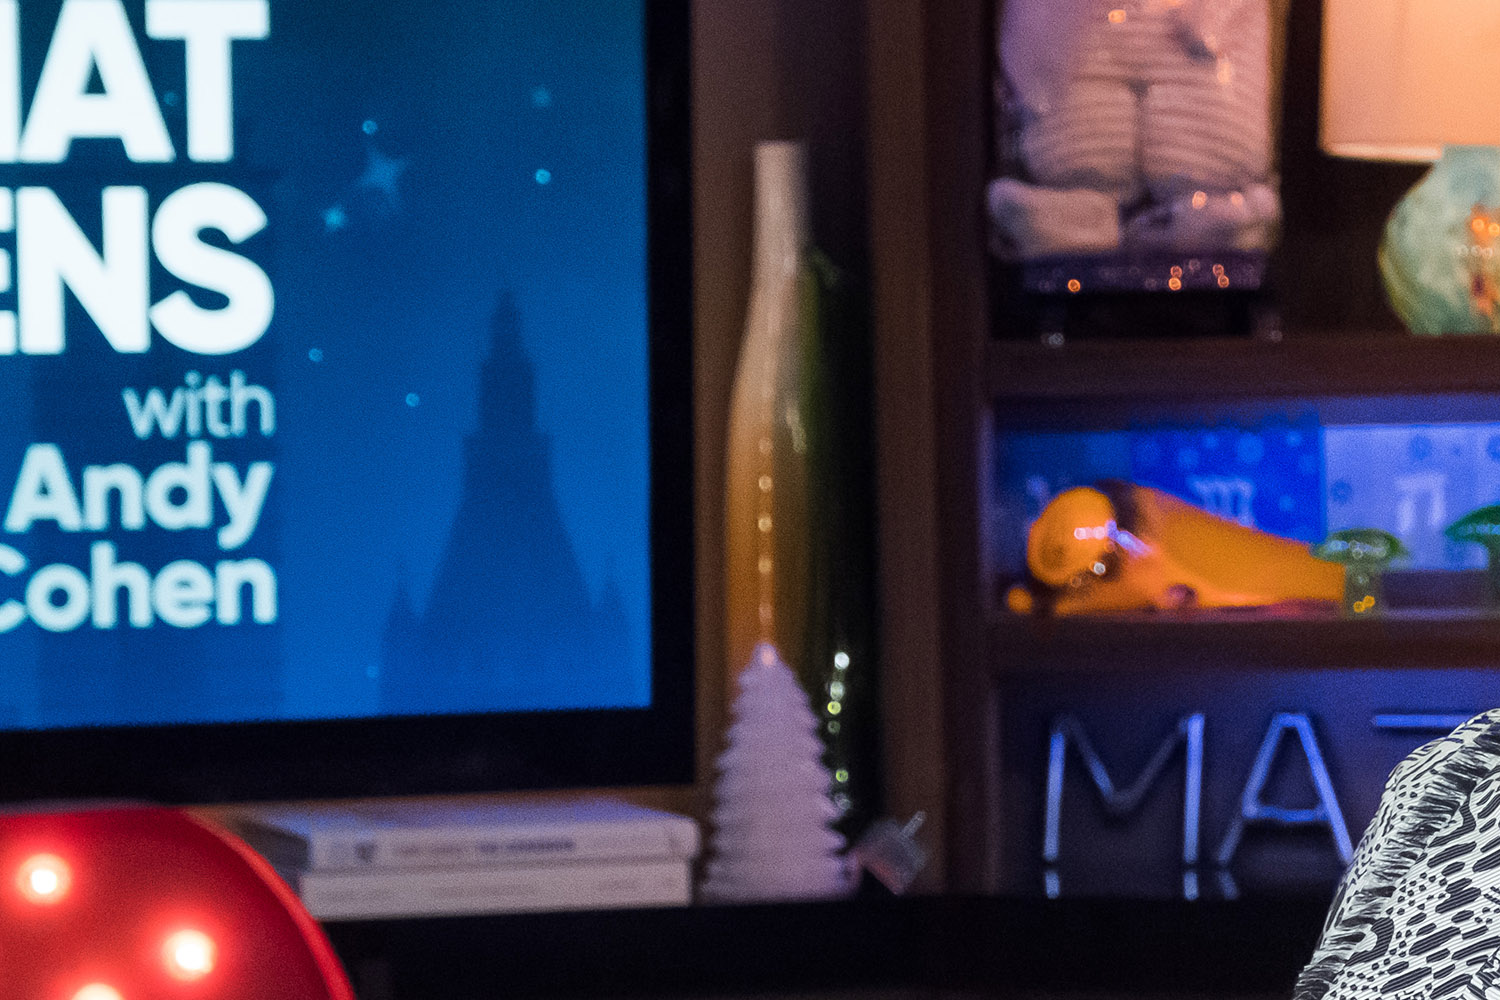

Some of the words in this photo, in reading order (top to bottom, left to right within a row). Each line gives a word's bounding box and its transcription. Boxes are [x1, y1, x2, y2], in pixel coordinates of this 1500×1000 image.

[0, 0, 270, 162] AT
[0, 182, 275, 355] NS
[122, 370, 276, 438] with
[3, 440, 274, 550] Andy
